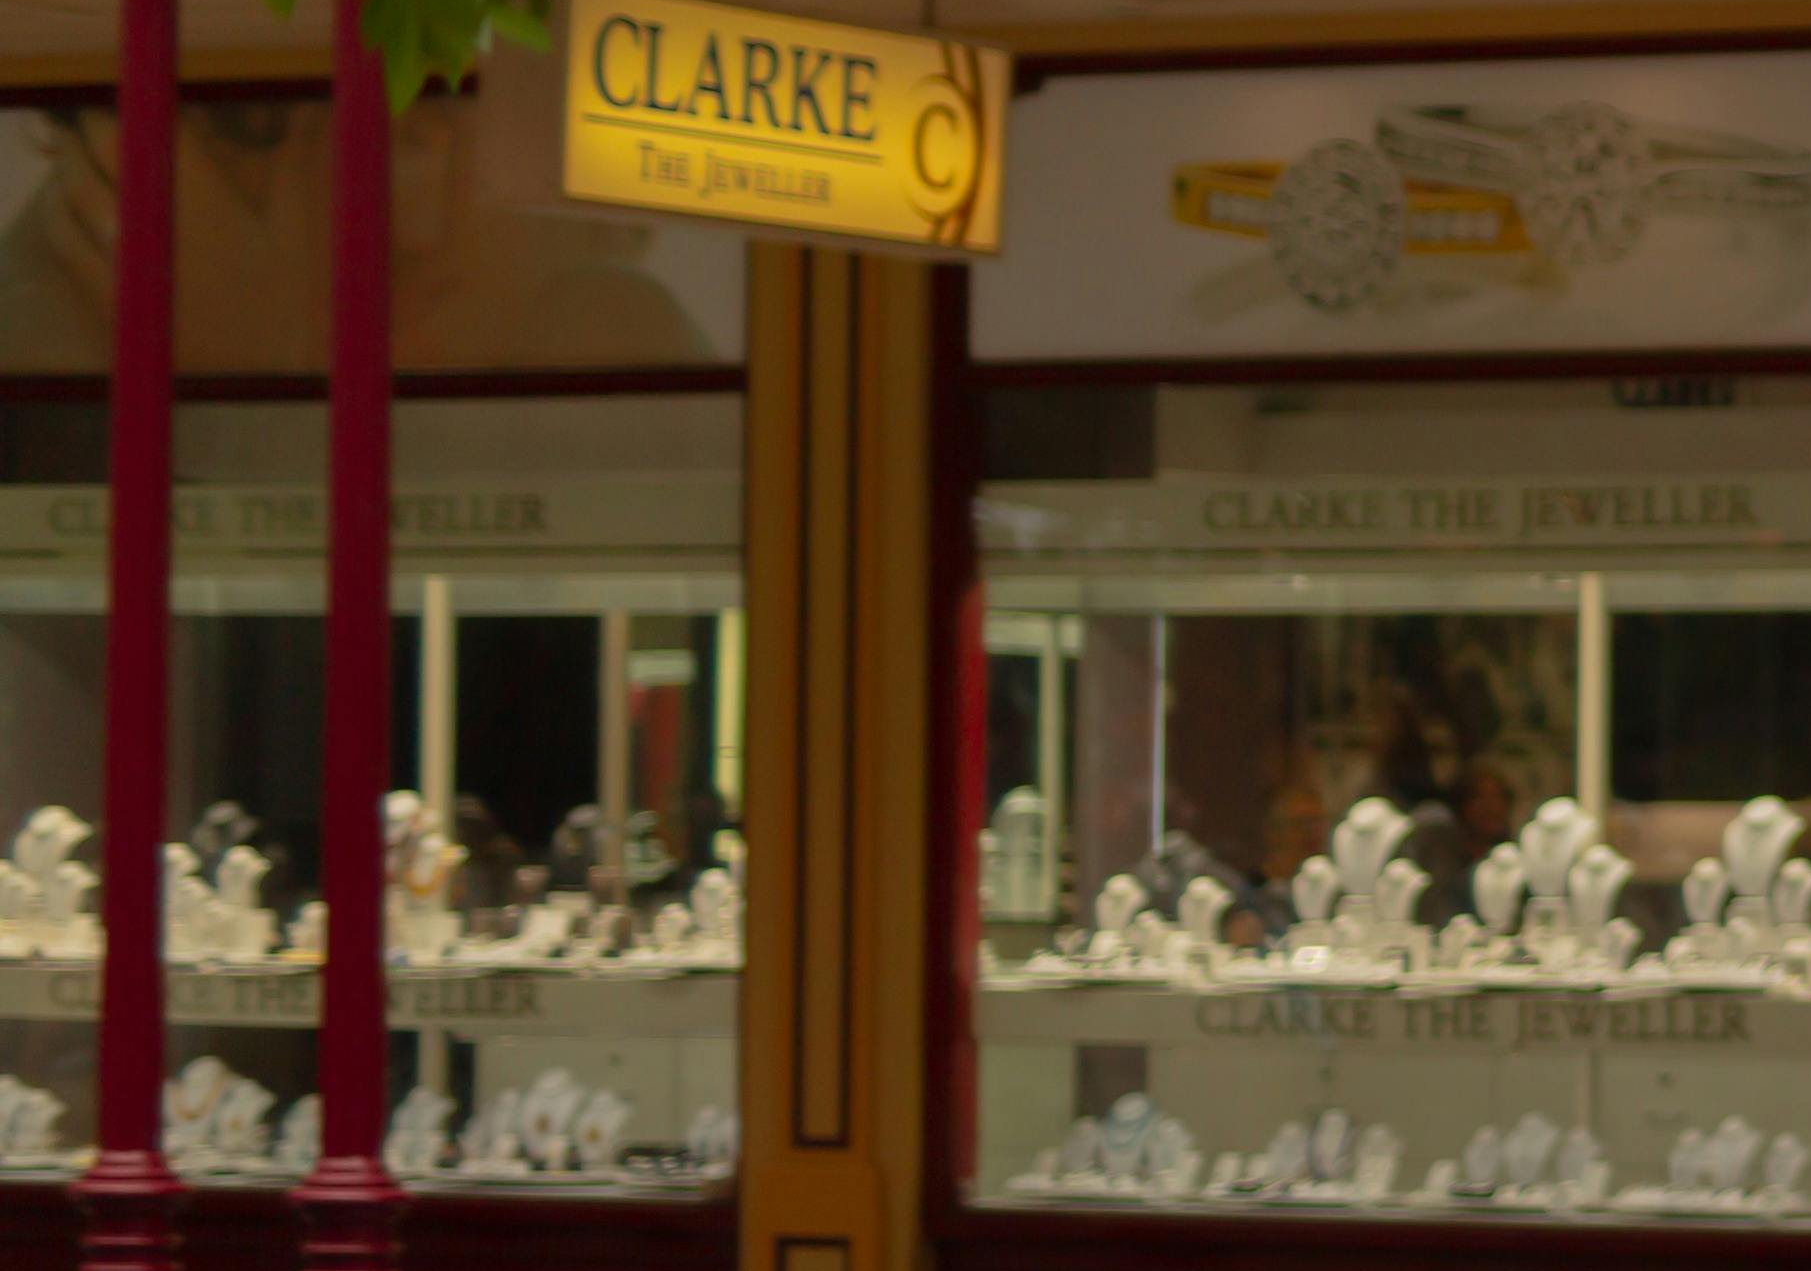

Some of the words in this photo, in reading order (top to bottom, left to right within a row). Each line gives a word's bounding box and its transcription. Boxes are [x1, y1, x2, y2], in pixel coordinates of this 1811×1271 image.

[594, 16, 876, 141] CLARKE
[45, 490, 217, 534] CLKE
[1202, 489, 1384, 532] CLARKE
[1402, 487, 1498, 531] THE
[1516, 485, 1760, 538] JEWELLER
[1196, 994, 1379, 1039] CLARKE
[1400, 995, 1492, 1039] THE
[1510, 994, 1753, 1049] JEWELLER
